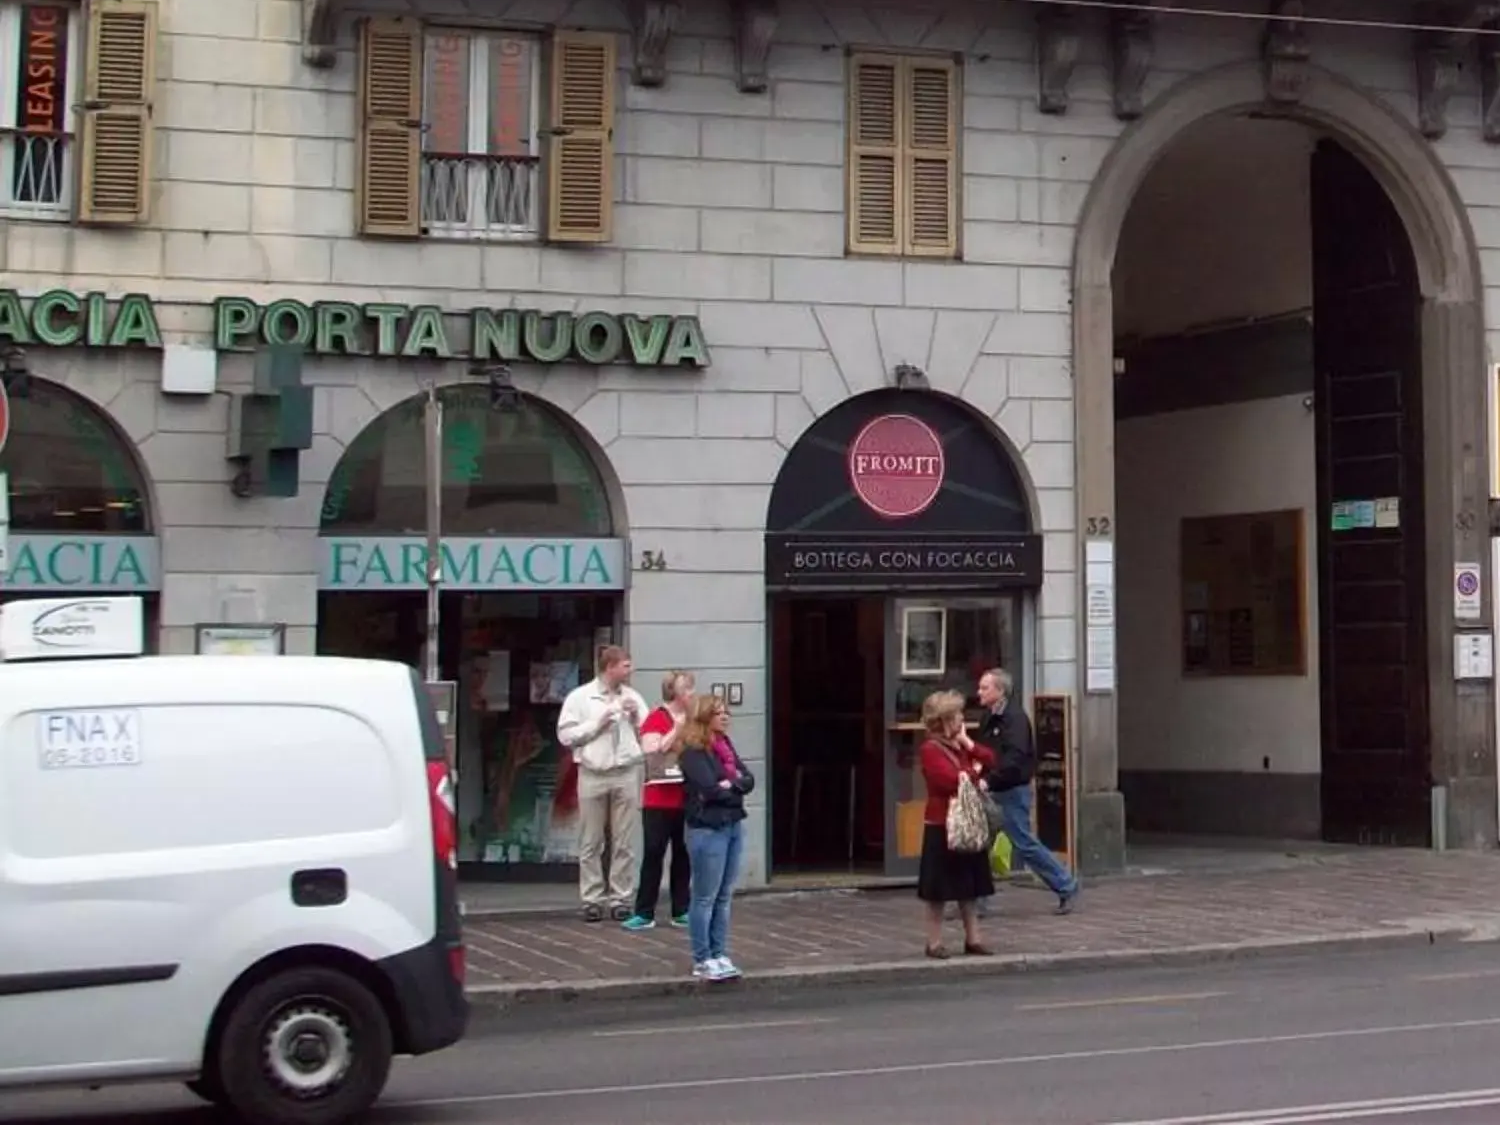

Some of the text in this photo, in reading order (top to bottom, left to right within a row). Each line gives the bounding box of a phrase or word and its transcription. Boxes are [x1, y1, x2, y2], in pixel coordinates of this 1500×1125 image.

[25, 6, 59, 133] LEASING
[213, 296, 454, 358] PORTA
[469, 306, 712, 369] NUOVA
[856, 453, 939, 475] FROMIT
[1086, 516, 1111, 536] 32
[330, 542, 613, 586] FARMACIA
[640, 550, 667, 572] 34
[794, 550, 1016, 569] BOTTEGA CON FOCACCIA
